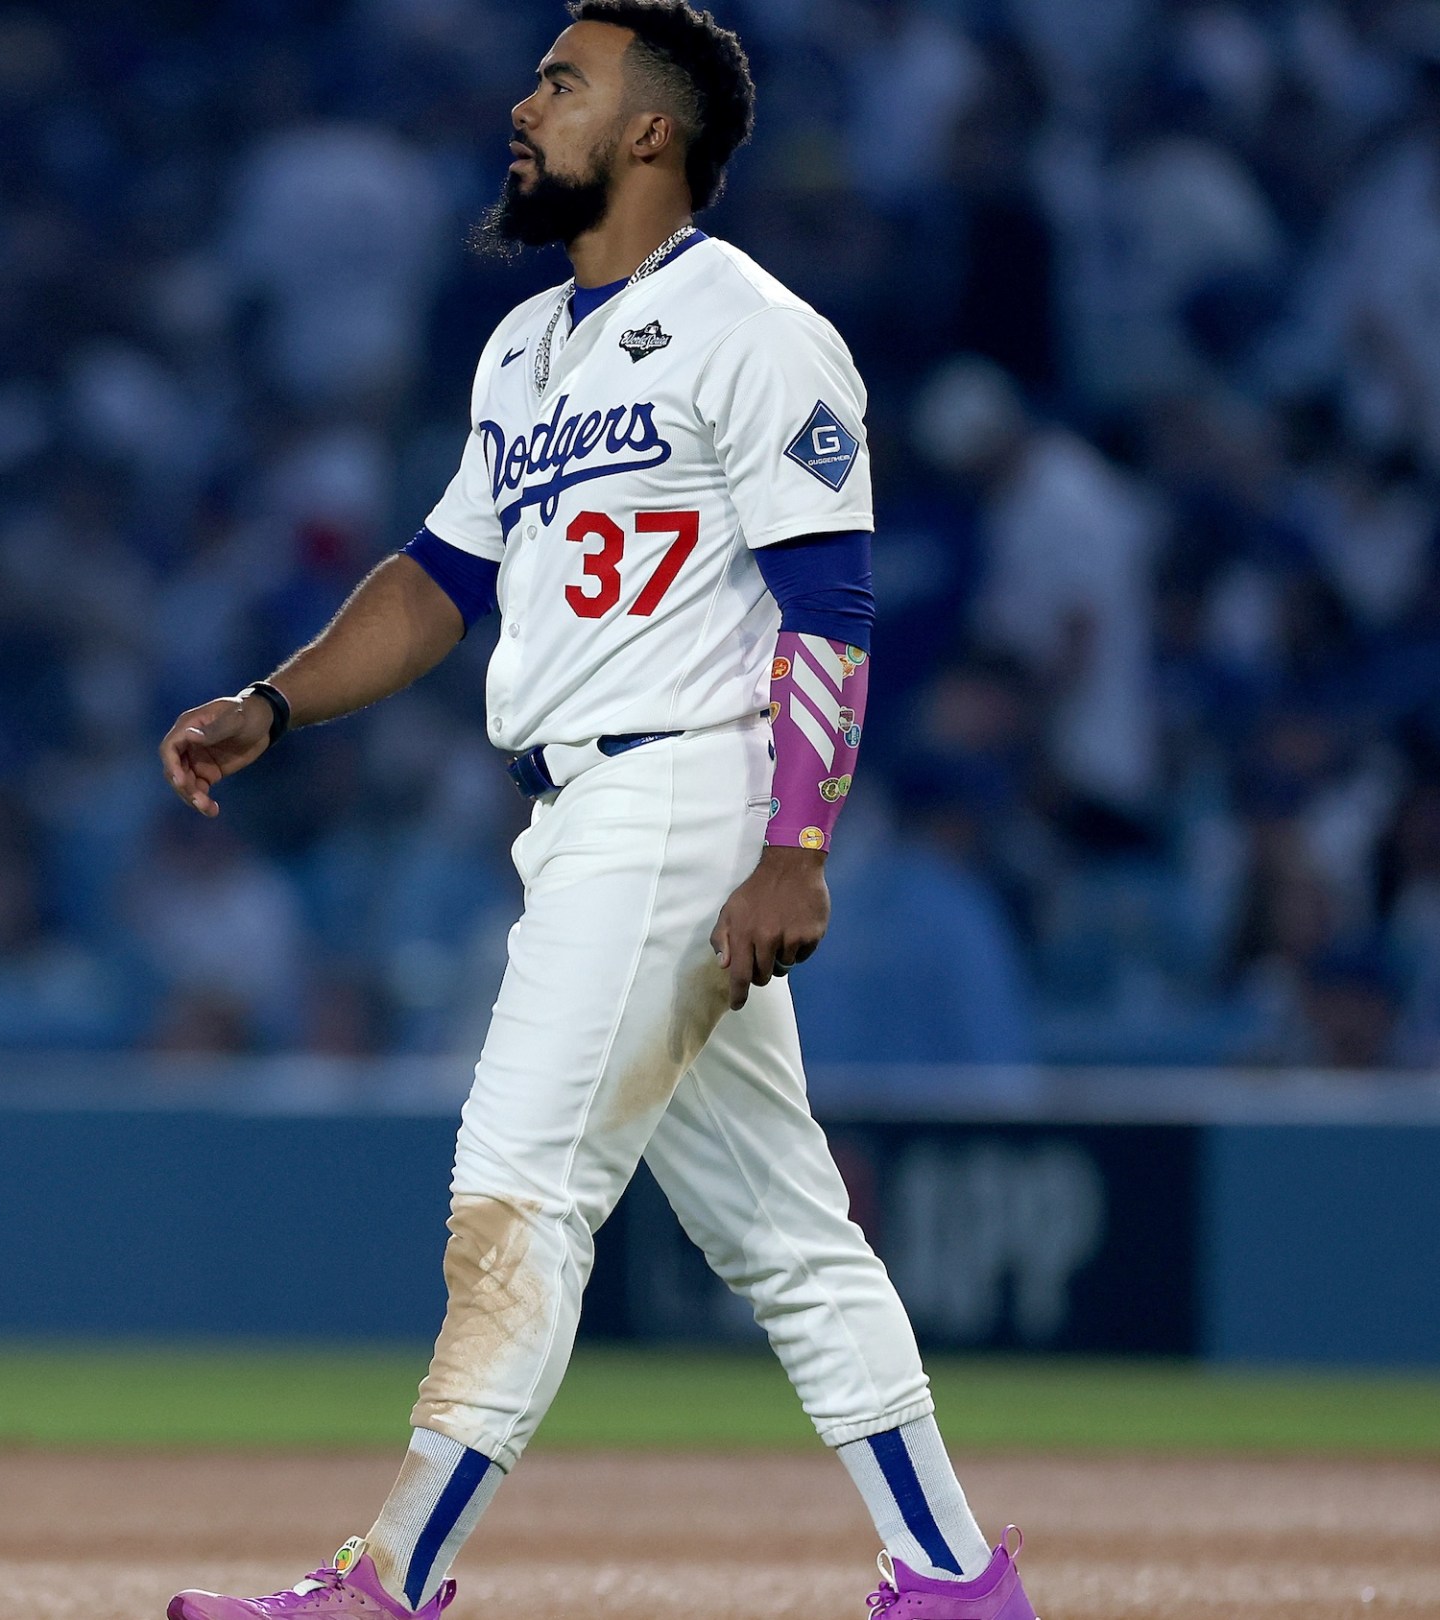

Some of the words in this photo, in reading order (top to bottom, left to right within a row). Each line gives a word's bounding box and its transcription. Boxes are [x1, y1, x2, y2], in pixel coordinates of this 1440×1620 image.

[478, 393, 672, 530] Dodgers
[811, 425, 841, 455] G
[564, 510, 700, 619] 37
